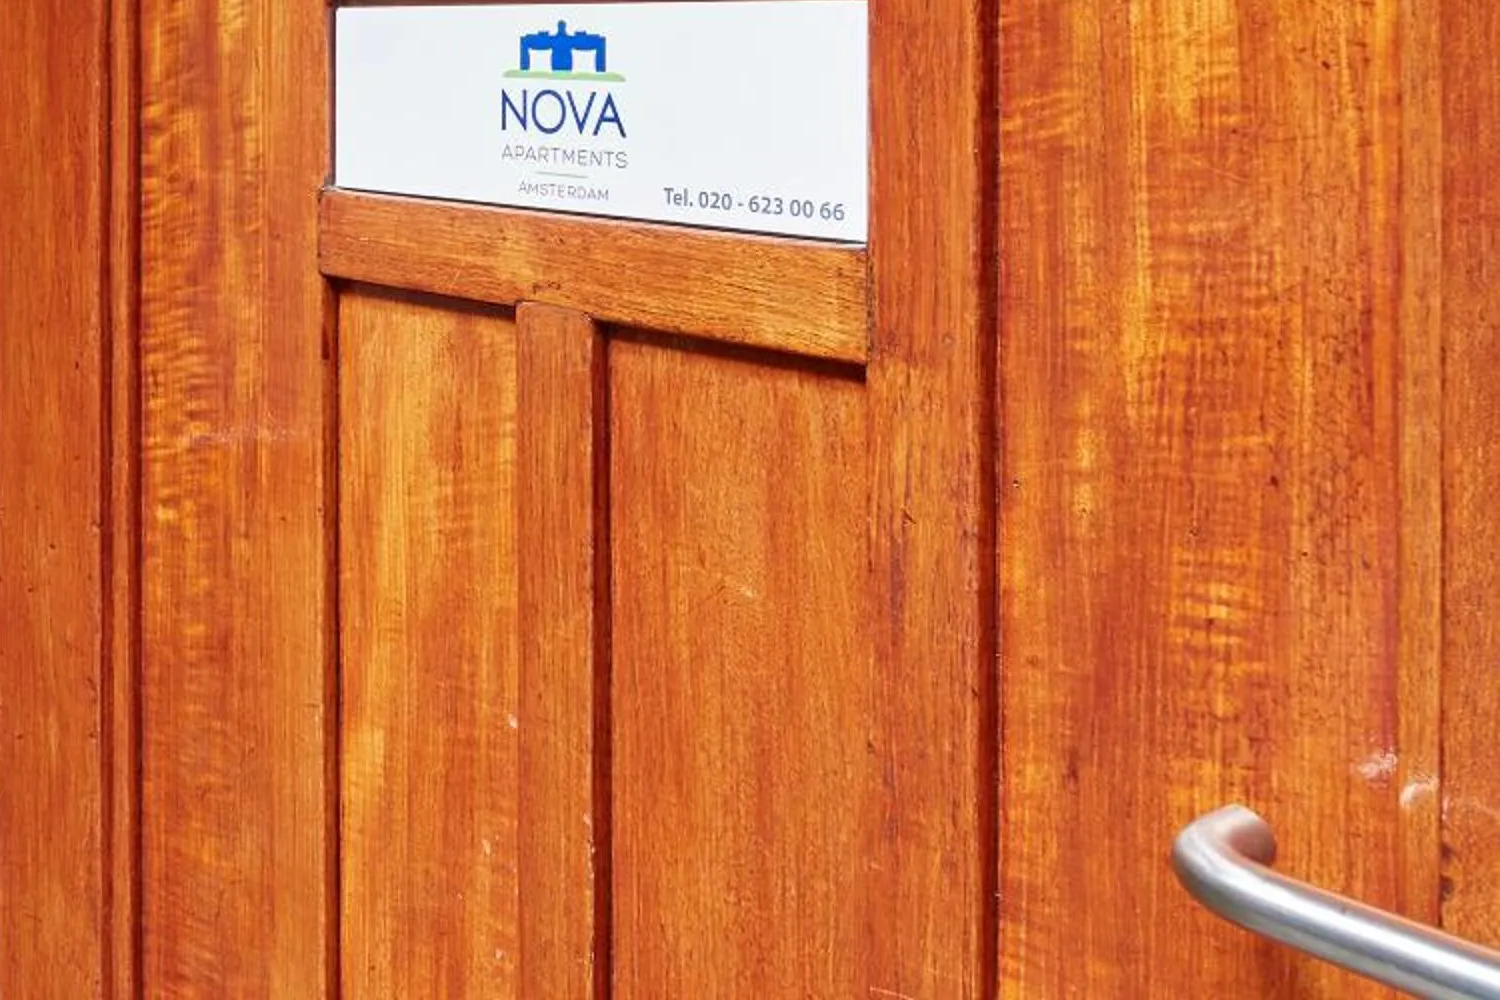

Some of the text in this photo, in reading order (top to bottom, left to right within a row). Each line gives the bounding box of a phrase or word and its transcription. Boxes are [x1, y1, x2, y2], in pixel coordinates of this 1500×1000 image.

[501, 88, 626, 138] NOVA
[501, 144, 629, 169] APARTMENTS
[518, 180, 610, 201] AMSTERDAM
[664, 187, 694, 208] Tel.
[698, 192, 733, 211] 020
[748, 195, 784, 216] 623
[789, 199, 815, 218] 00
[819, 202, 845, 221] 66
